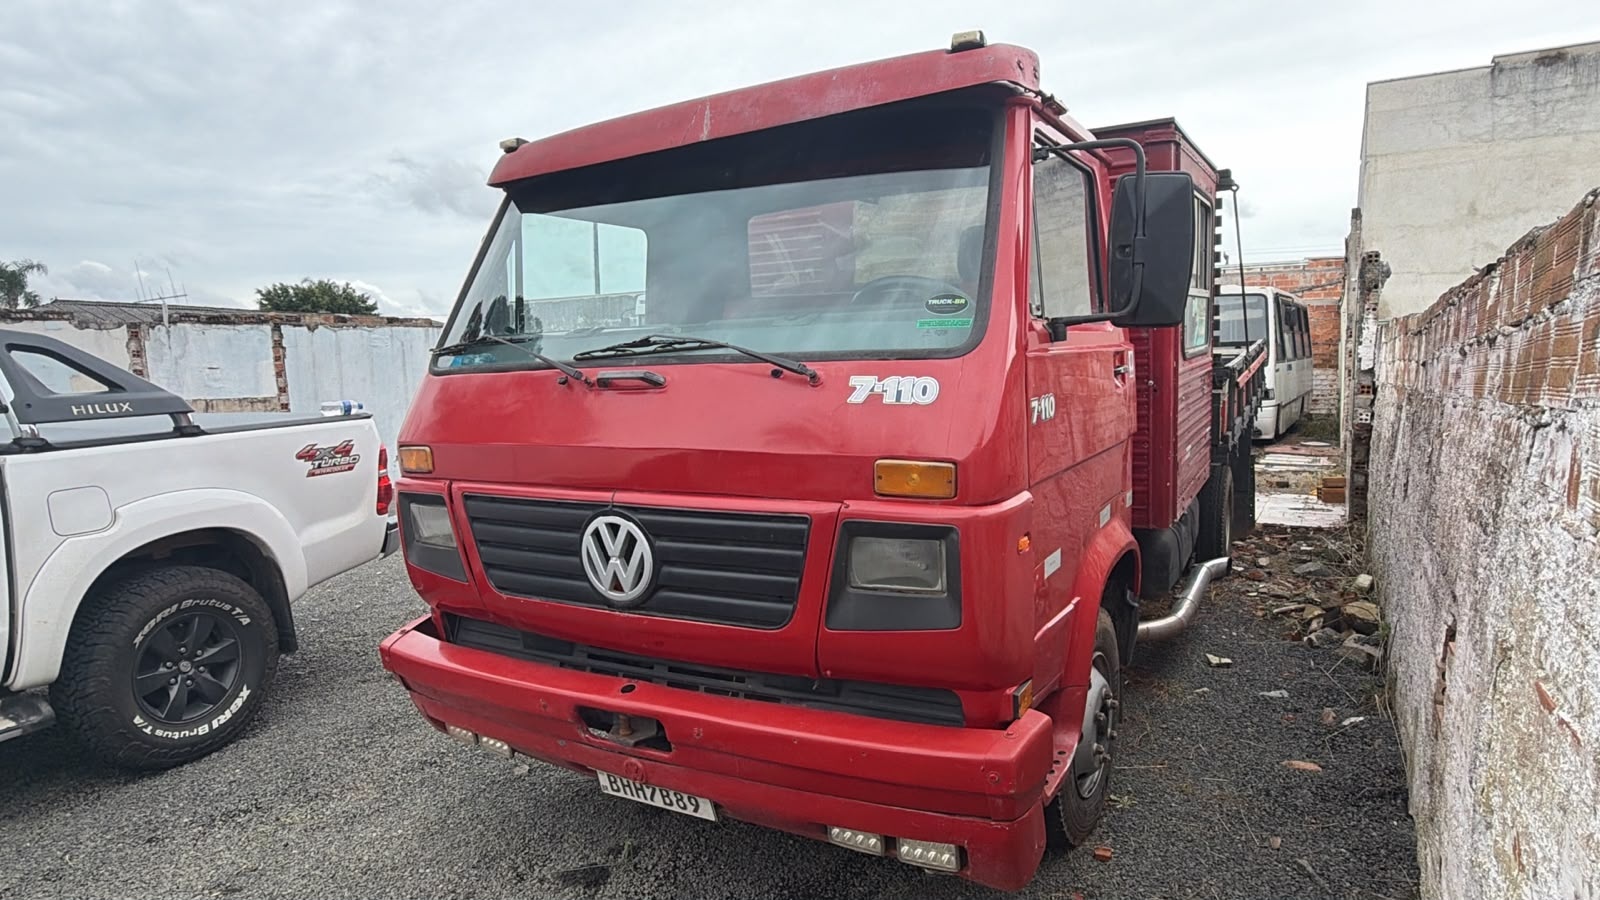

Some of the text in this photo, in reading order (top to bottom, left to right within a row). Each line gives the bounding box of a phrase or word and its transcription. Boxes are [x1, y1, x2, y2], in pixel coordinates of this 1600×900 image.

[71, 402, 133, 416] HILUX
[311, 454, 361, 469] TURBO
[180, 599, 232, 612] Brutus
[231, 607, 251, 626] T/A
[133, 715, 153, 735] T/A
[154, 724, 209, 739] Brutus
[607, 773, 700, 814] BHH7B89
